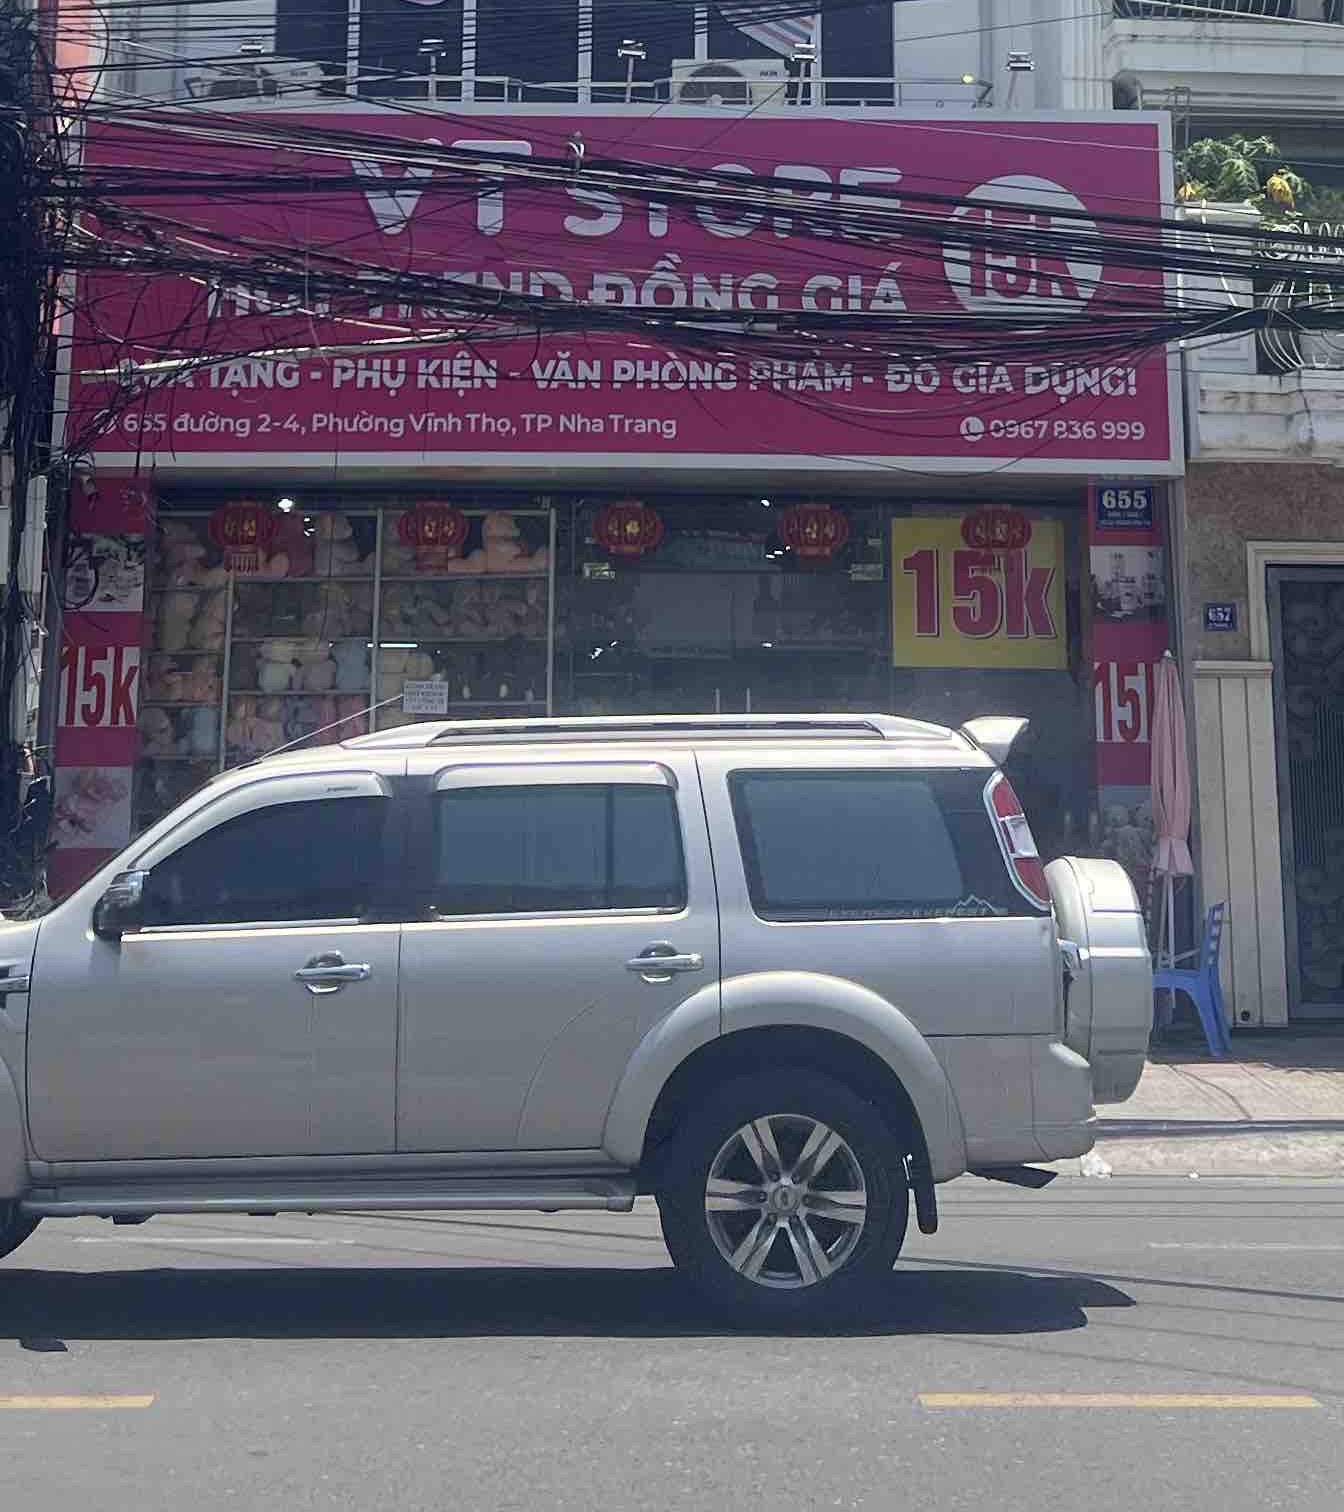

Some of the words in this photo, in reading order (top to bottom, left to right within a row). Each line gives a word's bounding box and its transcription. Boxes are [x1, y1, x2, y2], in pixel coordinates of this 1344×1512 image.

[332, 359, 407, 397] PHỤ
[417, 351, 498, 397] KIỆN
[532, 350, 603, 390] VĂN
[613, 350, 737, 390] PHÒNG
[173, 410, 251, 438] đường
[257, 413, 307, 435] 2-4,
[311, 409, 410, 438] Phường
[413, 410, 465, 434] Vĩnh
[521, 414, 553, 434] TP
[559, 414, 604, 434] Nha
[608, 414, 677, 438] Trang
[989, 420, 1048, 439] 0967
[1102, 421, 1146, 441] 999
[1102, 489, 1148, 509] 655
[902, 546, 1058, 640] 15k
[1094, 662, 1155, 742] 15
